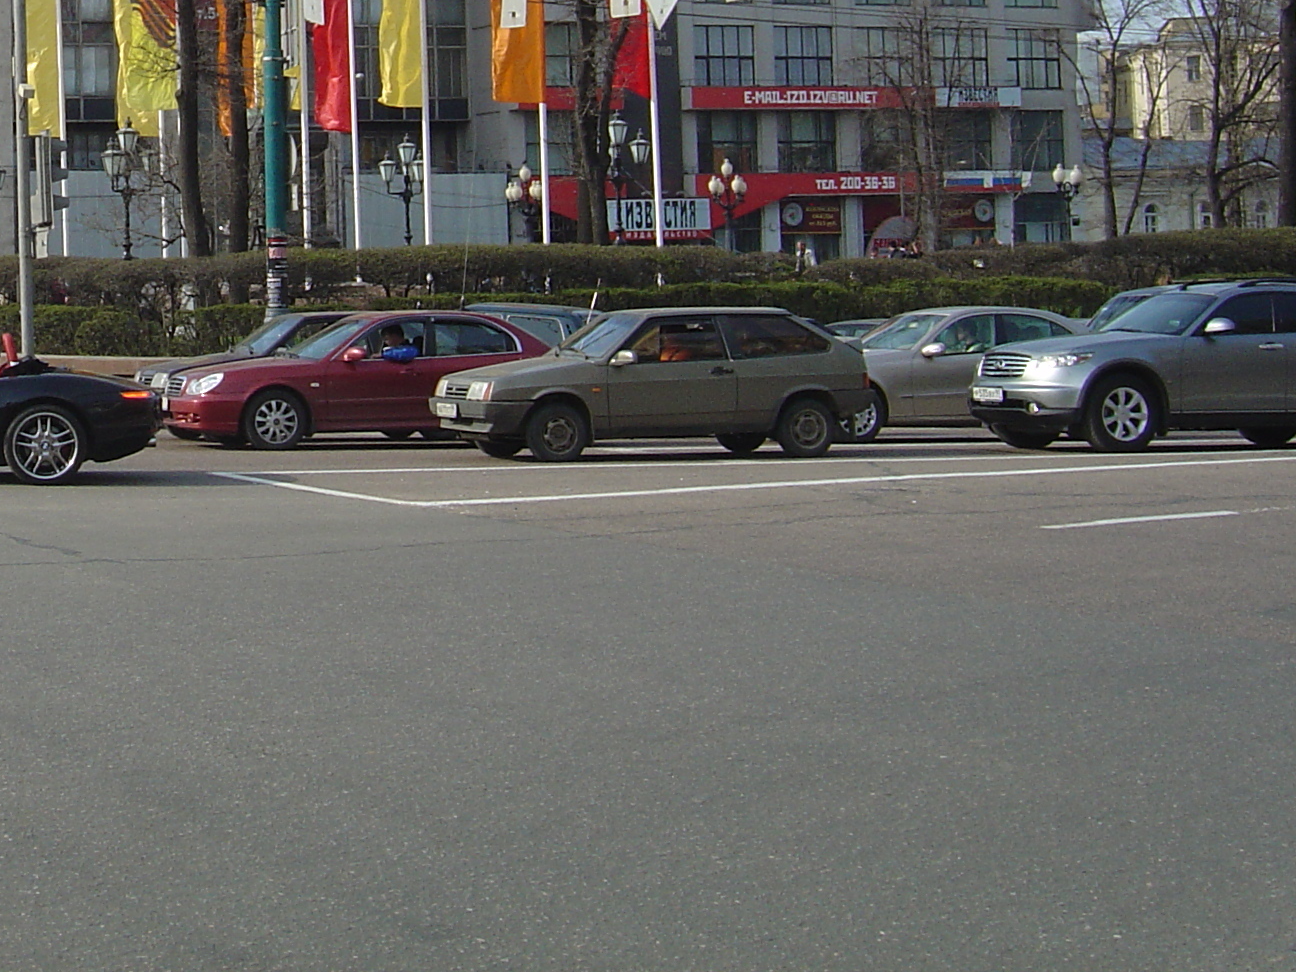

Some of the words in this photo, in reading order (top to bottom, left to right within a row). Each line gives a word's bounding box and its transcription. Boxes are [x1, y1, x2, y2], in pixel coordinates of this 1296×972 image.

[815, 179, 838, 190] ТЕЛ.
[840, 177, 896, 190] 200-36-36
[625, 201, 696, 229] ИЗВСТИЯ
